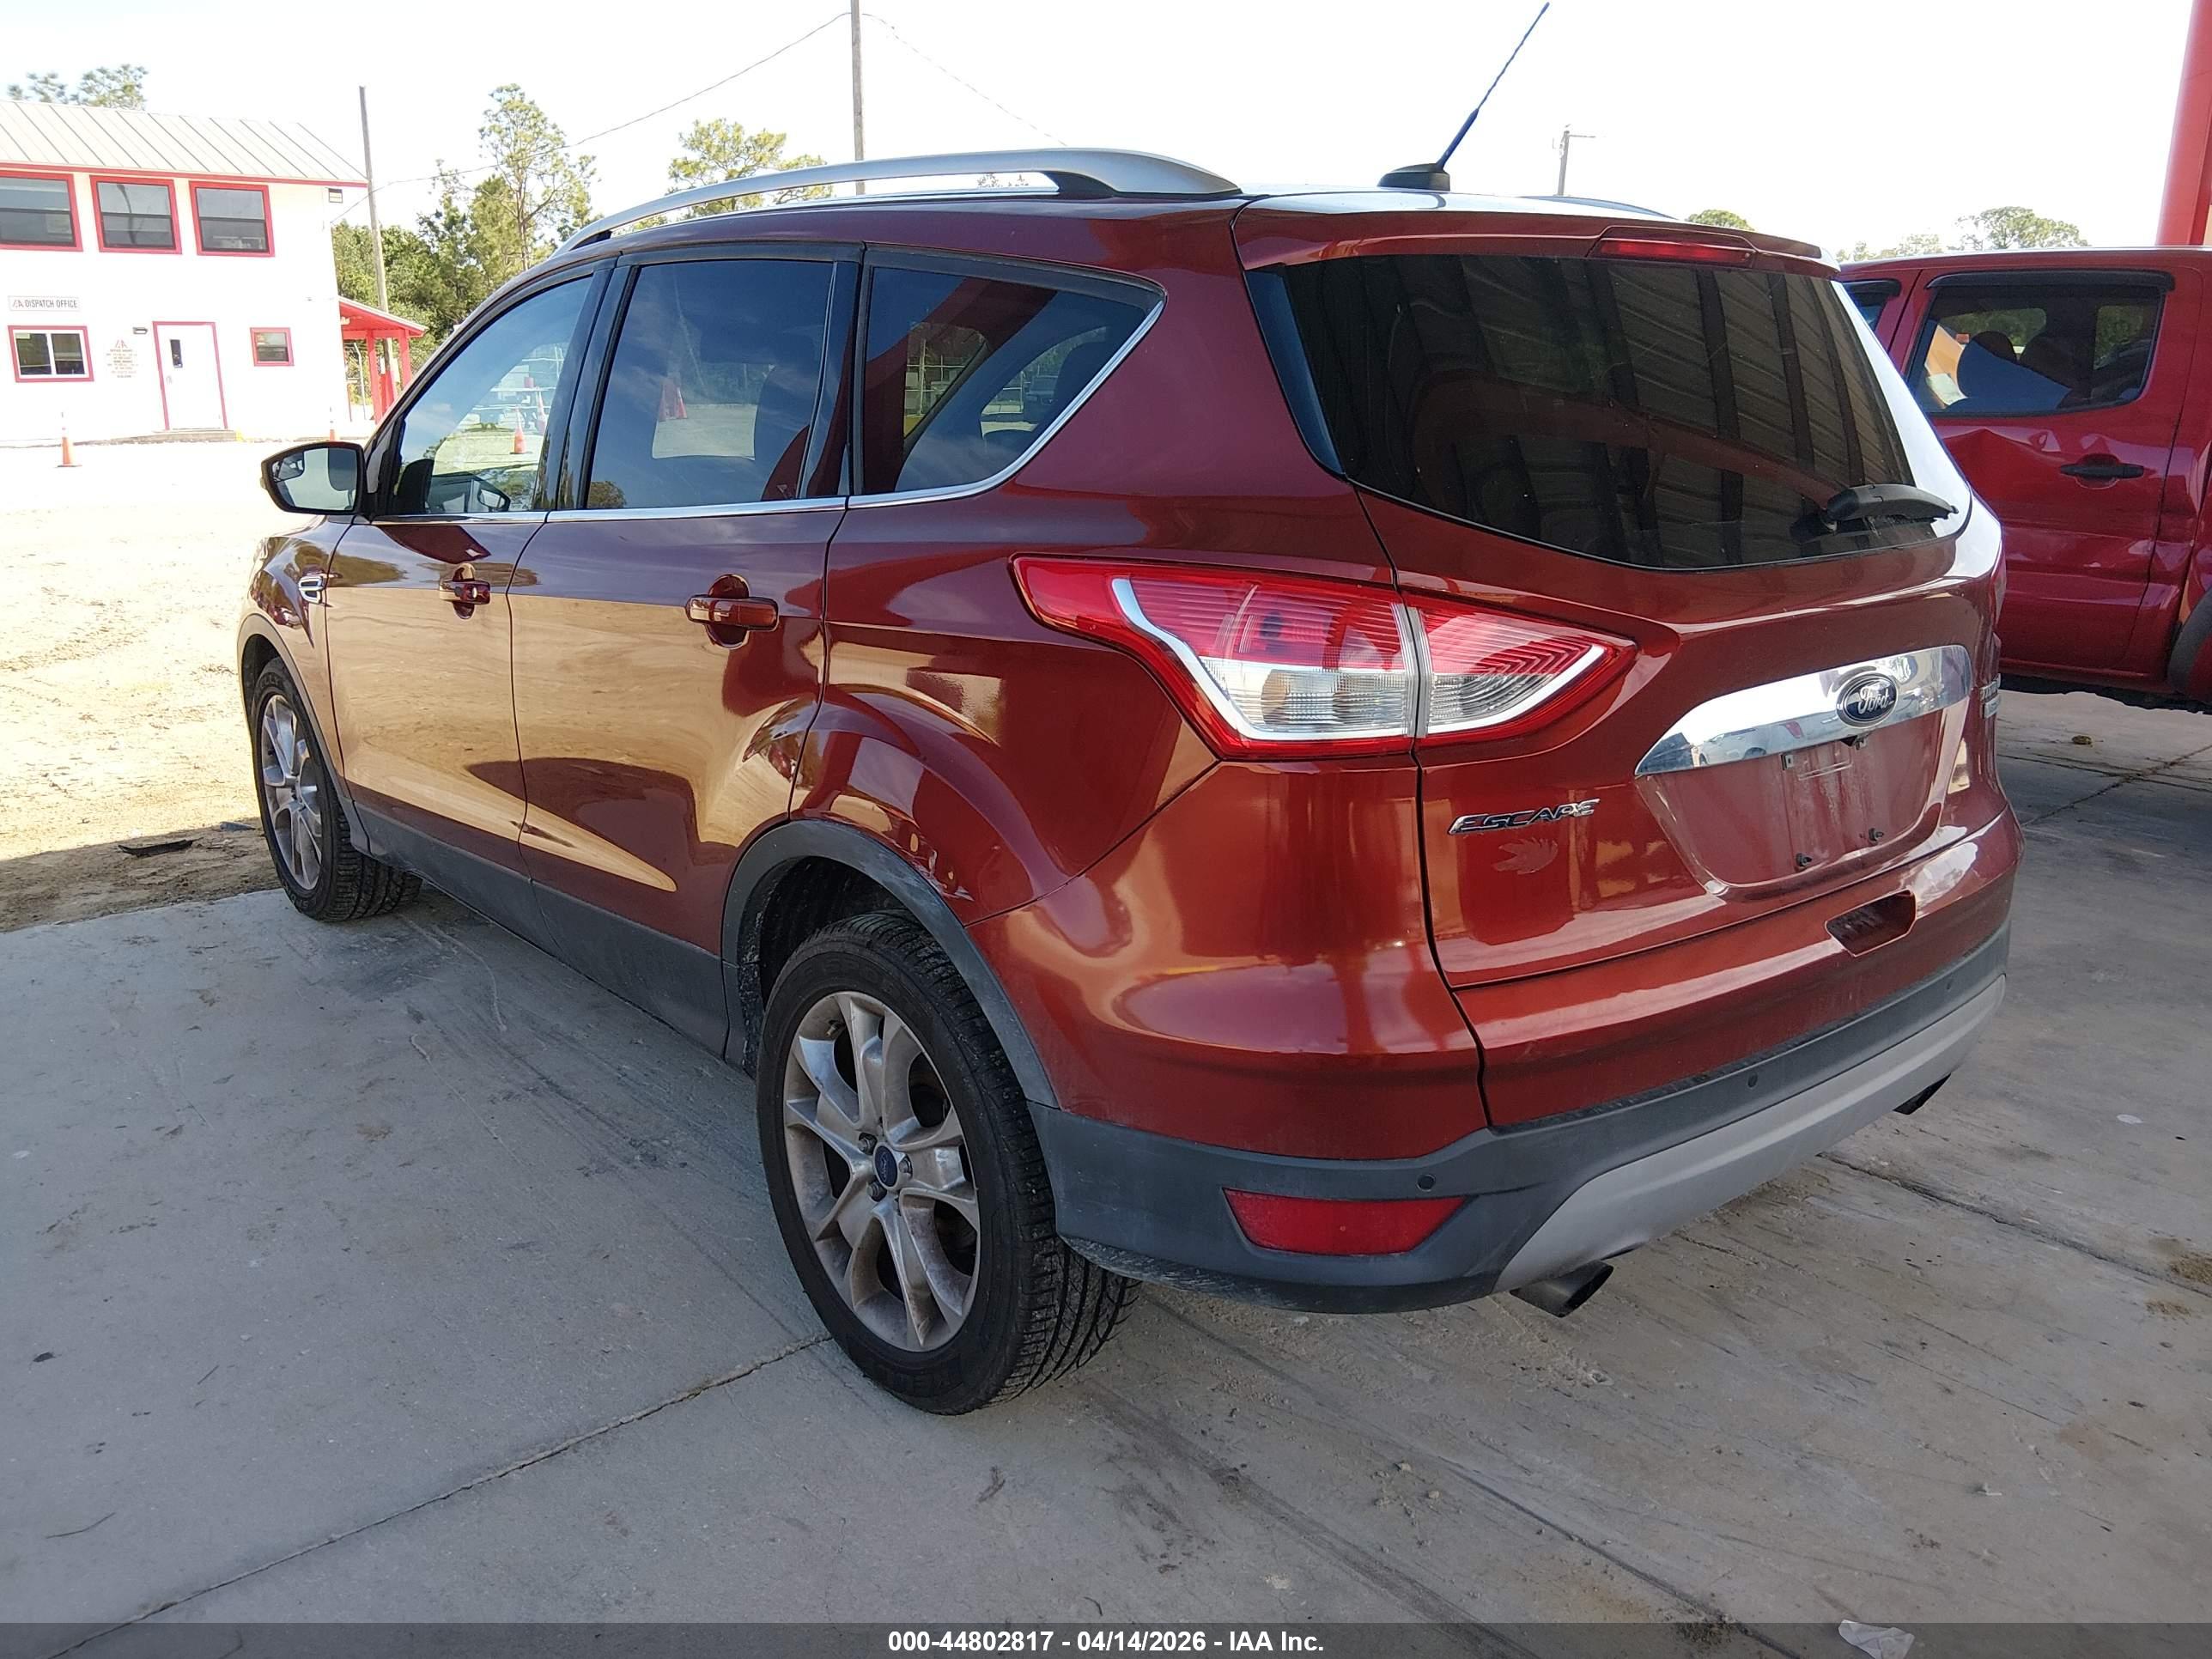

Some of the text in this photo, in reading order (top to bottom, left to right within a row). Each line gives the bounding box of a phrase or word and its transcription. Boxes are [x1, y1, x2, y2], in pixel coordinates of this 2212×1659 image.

[25, 299, 54, 308] DISPATCH
[56, 300, 78, 308] OFFICE
[1857, 684, 1894, 714] Ford
[1449, 798, 1601, 835] ESCAPE
